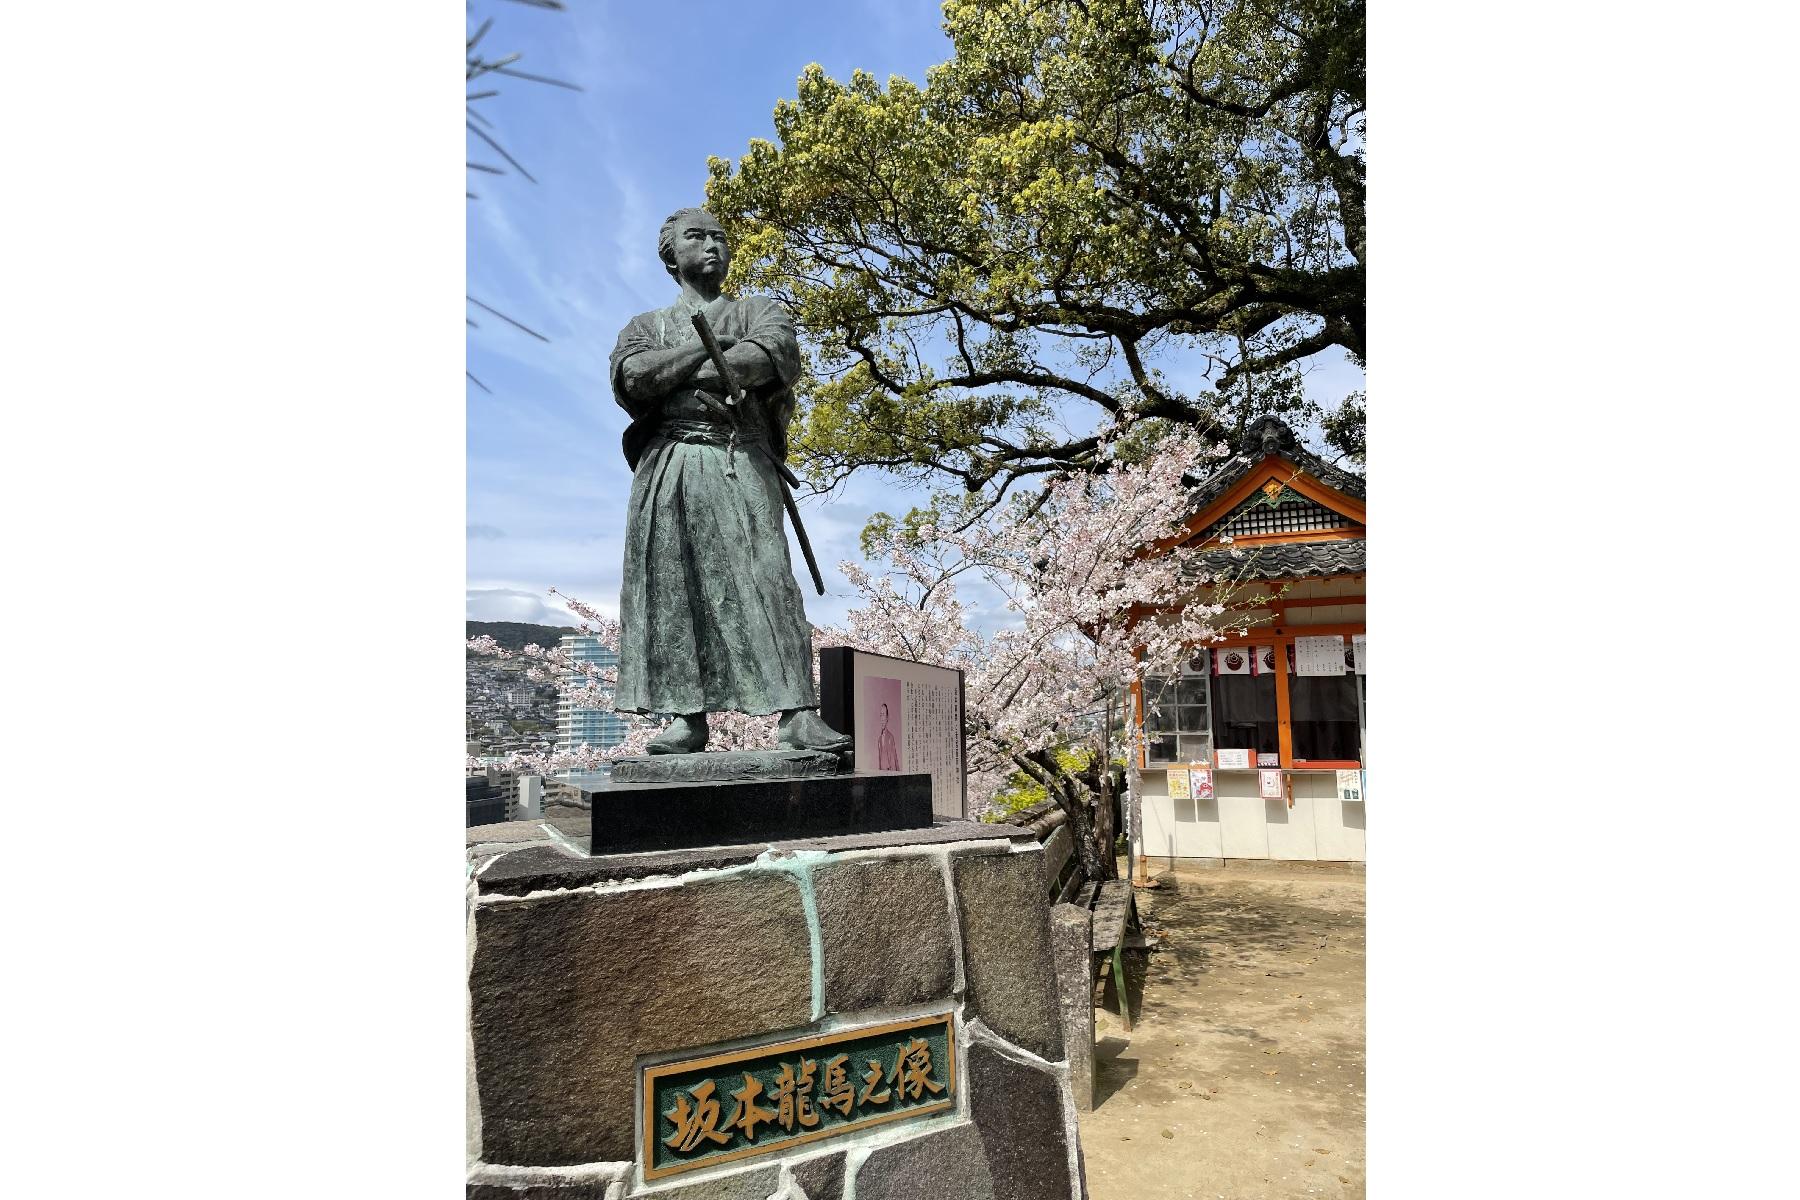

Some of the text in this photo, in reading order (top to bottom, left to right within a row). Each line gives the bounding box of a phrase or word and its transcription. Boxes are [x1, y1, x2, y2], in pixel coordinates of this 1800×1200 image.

[665, 1037, 945, 1152] 坂本龍馬之像
